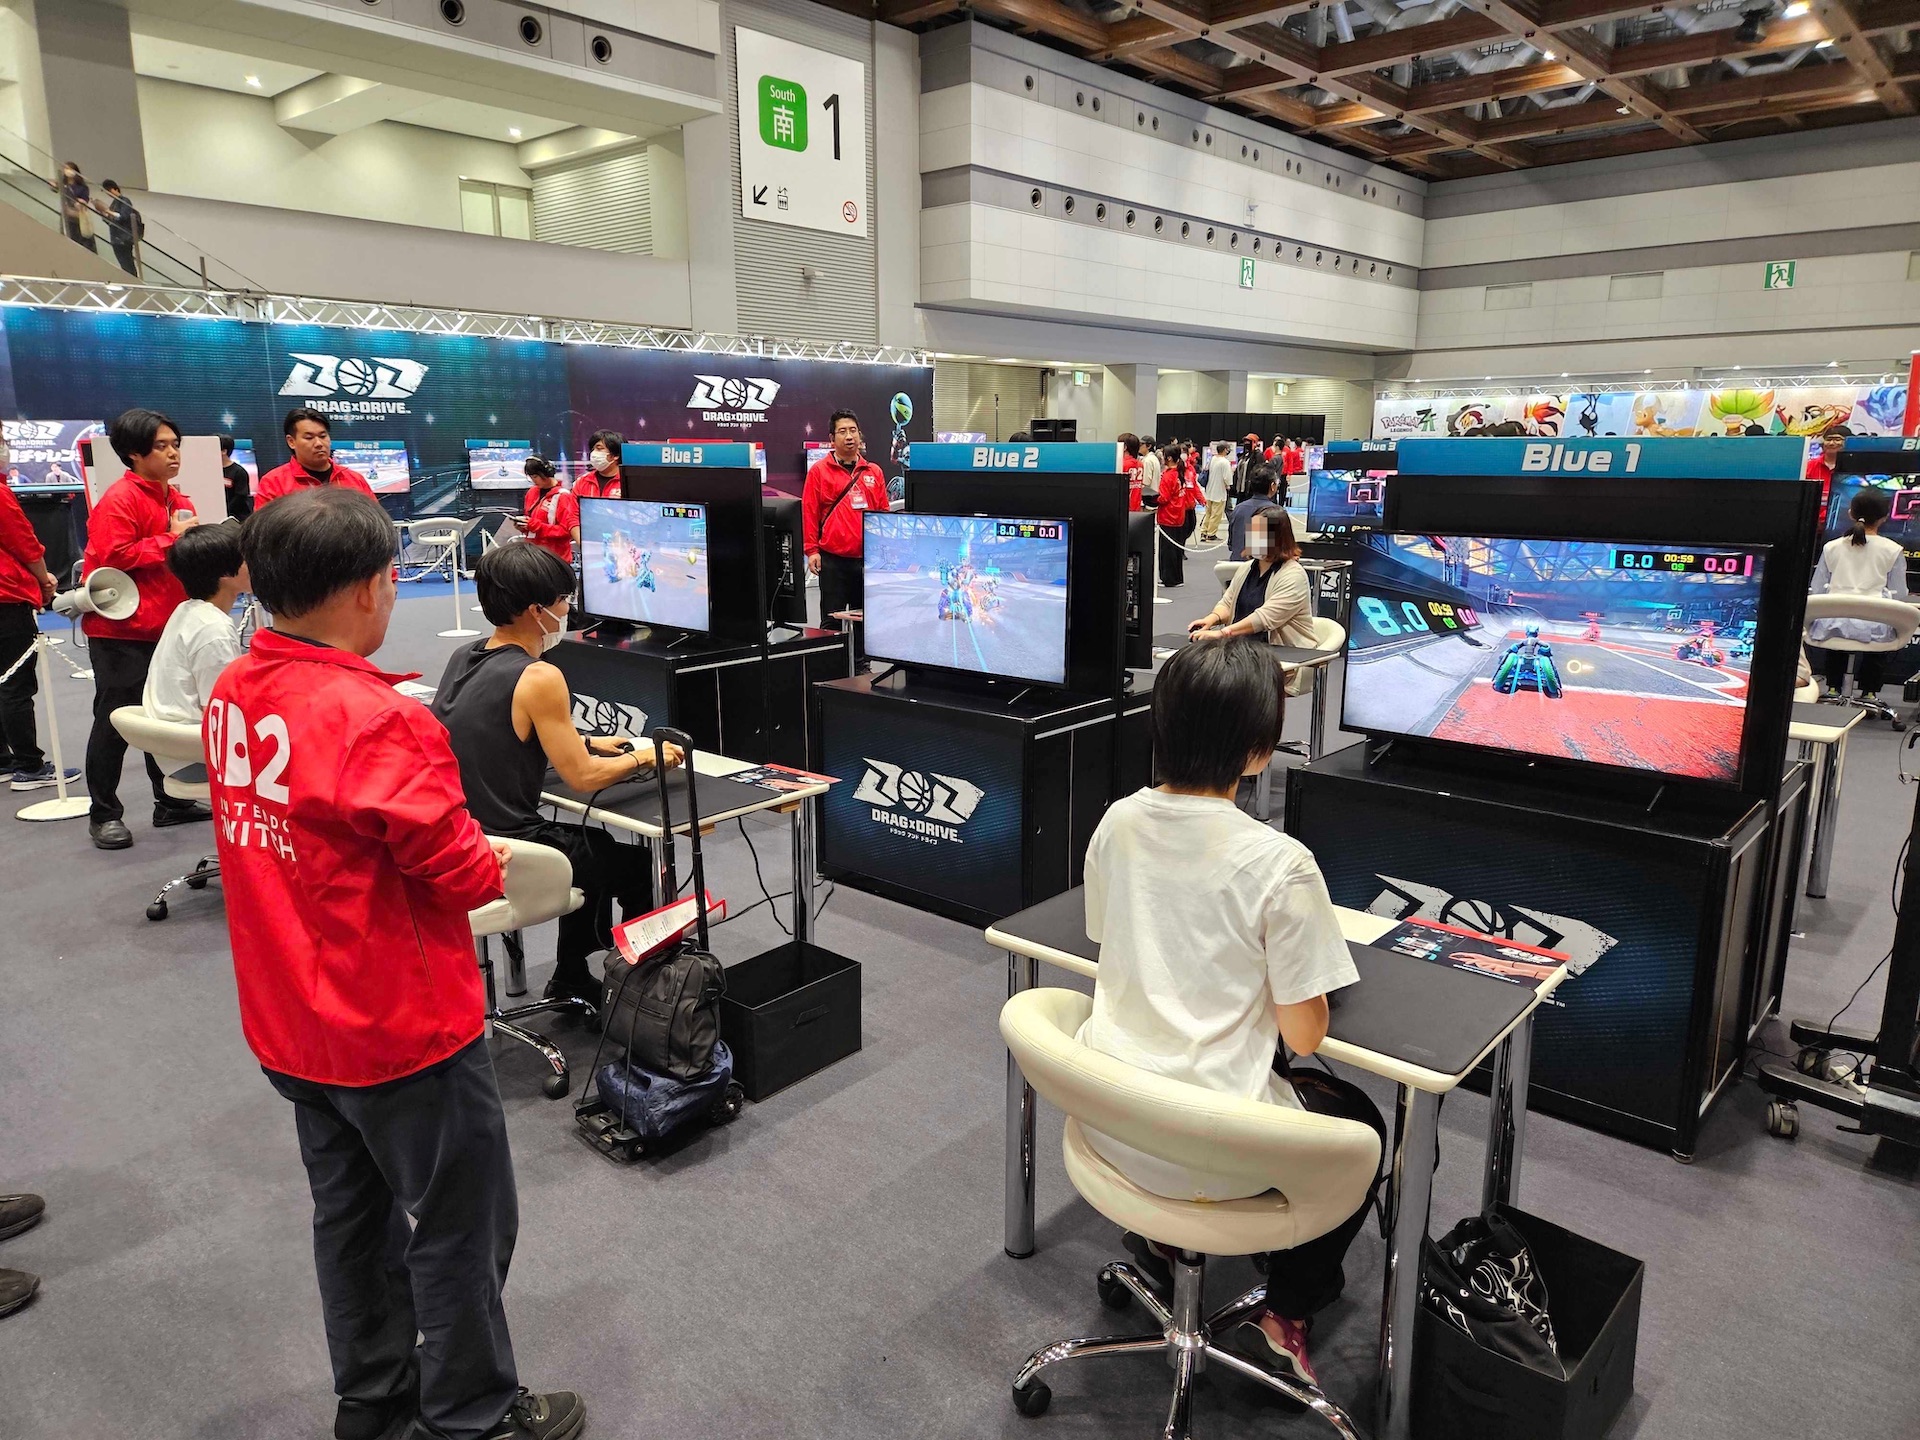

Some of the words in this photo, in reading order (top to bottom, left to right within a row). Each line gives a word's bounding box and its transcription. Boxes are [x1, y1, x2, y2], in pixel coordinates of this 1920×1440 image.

[769, 84, 796, 103] South
[772, 104, 795, 144] 南
[823, 93, 841, 161] 1
[353, 441, 370, 449] Blue
[661, 446, 691, 464] Blue
[692, 446, 703, 464] 3
[1361, 442, 1387, 451] Blue
[1388, 441, 1397, 451] 3
[972, 446, 1020, 468] Blue
[1022, 446, 1039, 468] 2
[1521, 443, 1613, 472] Blue
[1625, 443, 1641, 472] 1
[999, 525, 1016, 536] 8.0
[1039, 527, 1056, 538] 0.0
[1623, 554, 1654, 568] 8.0
[1663, 554, 1695, 563] 00:59
[1704, 557, 1738, 572] 0.0
[1357, 595, 1430, 636] 8.0
[254, 713, 291, 805] 2
